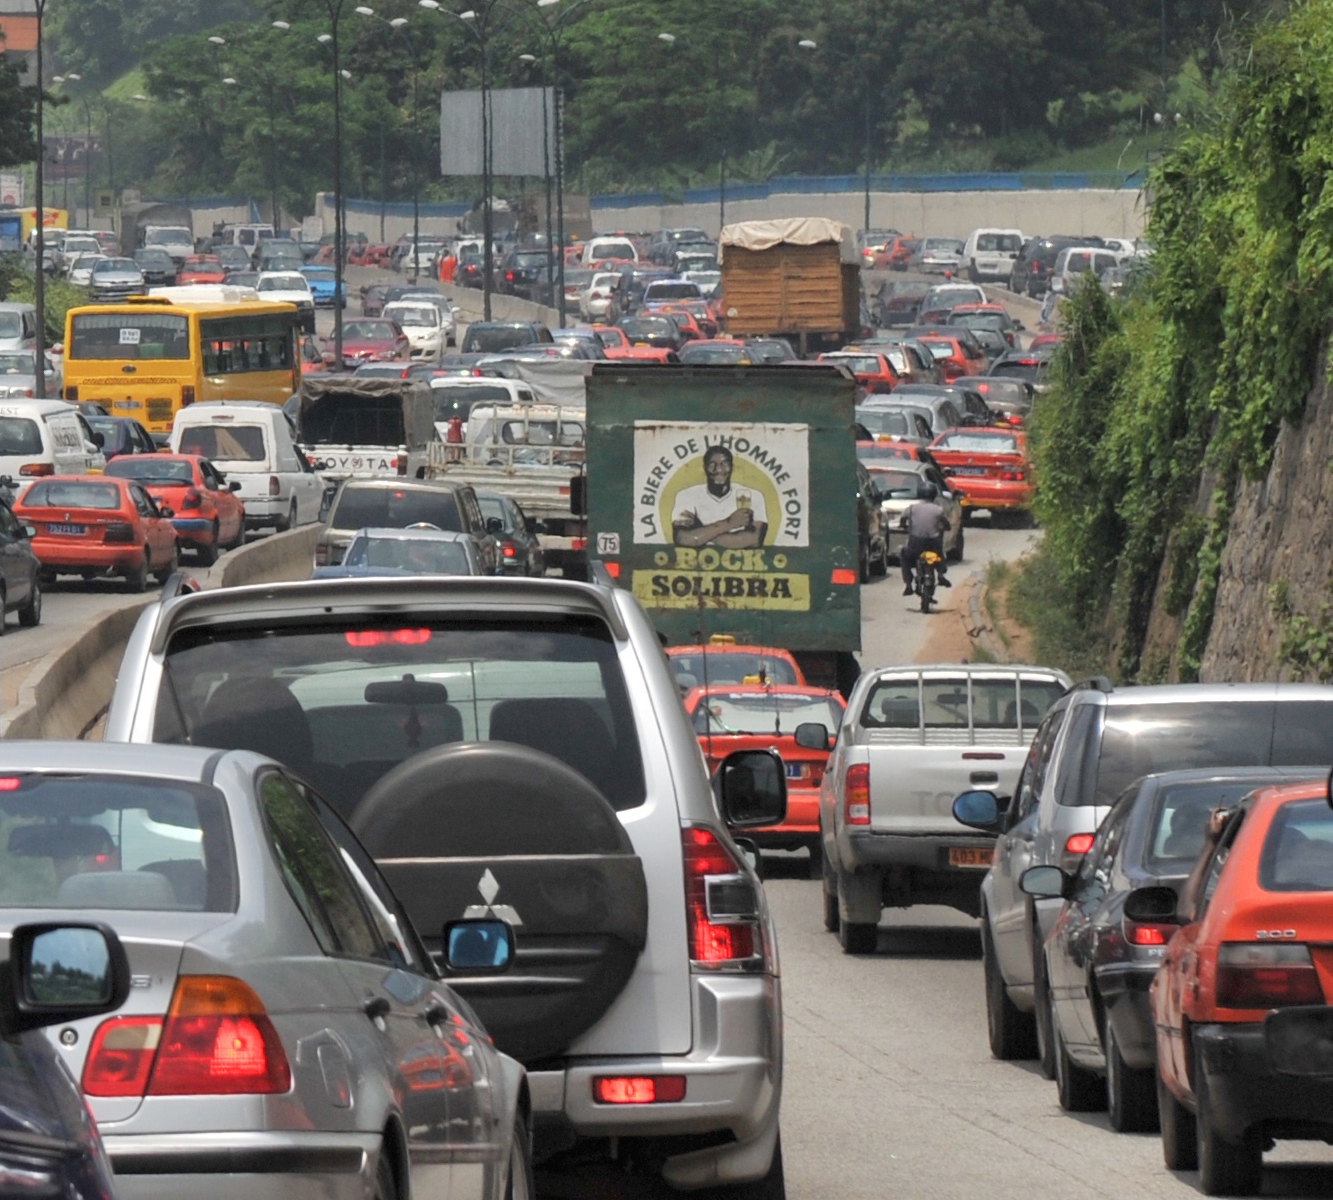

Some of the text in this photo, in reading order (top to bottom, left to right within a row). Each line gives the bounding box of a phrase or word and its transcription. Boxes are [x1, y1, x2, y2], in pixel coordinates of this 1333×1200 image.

[640, 434, 802, 541] LA BIERE DE L'HOMME FORT
[602, 536, 617, 550] 75
[651, 575, 793, 598] SOLIBRA
